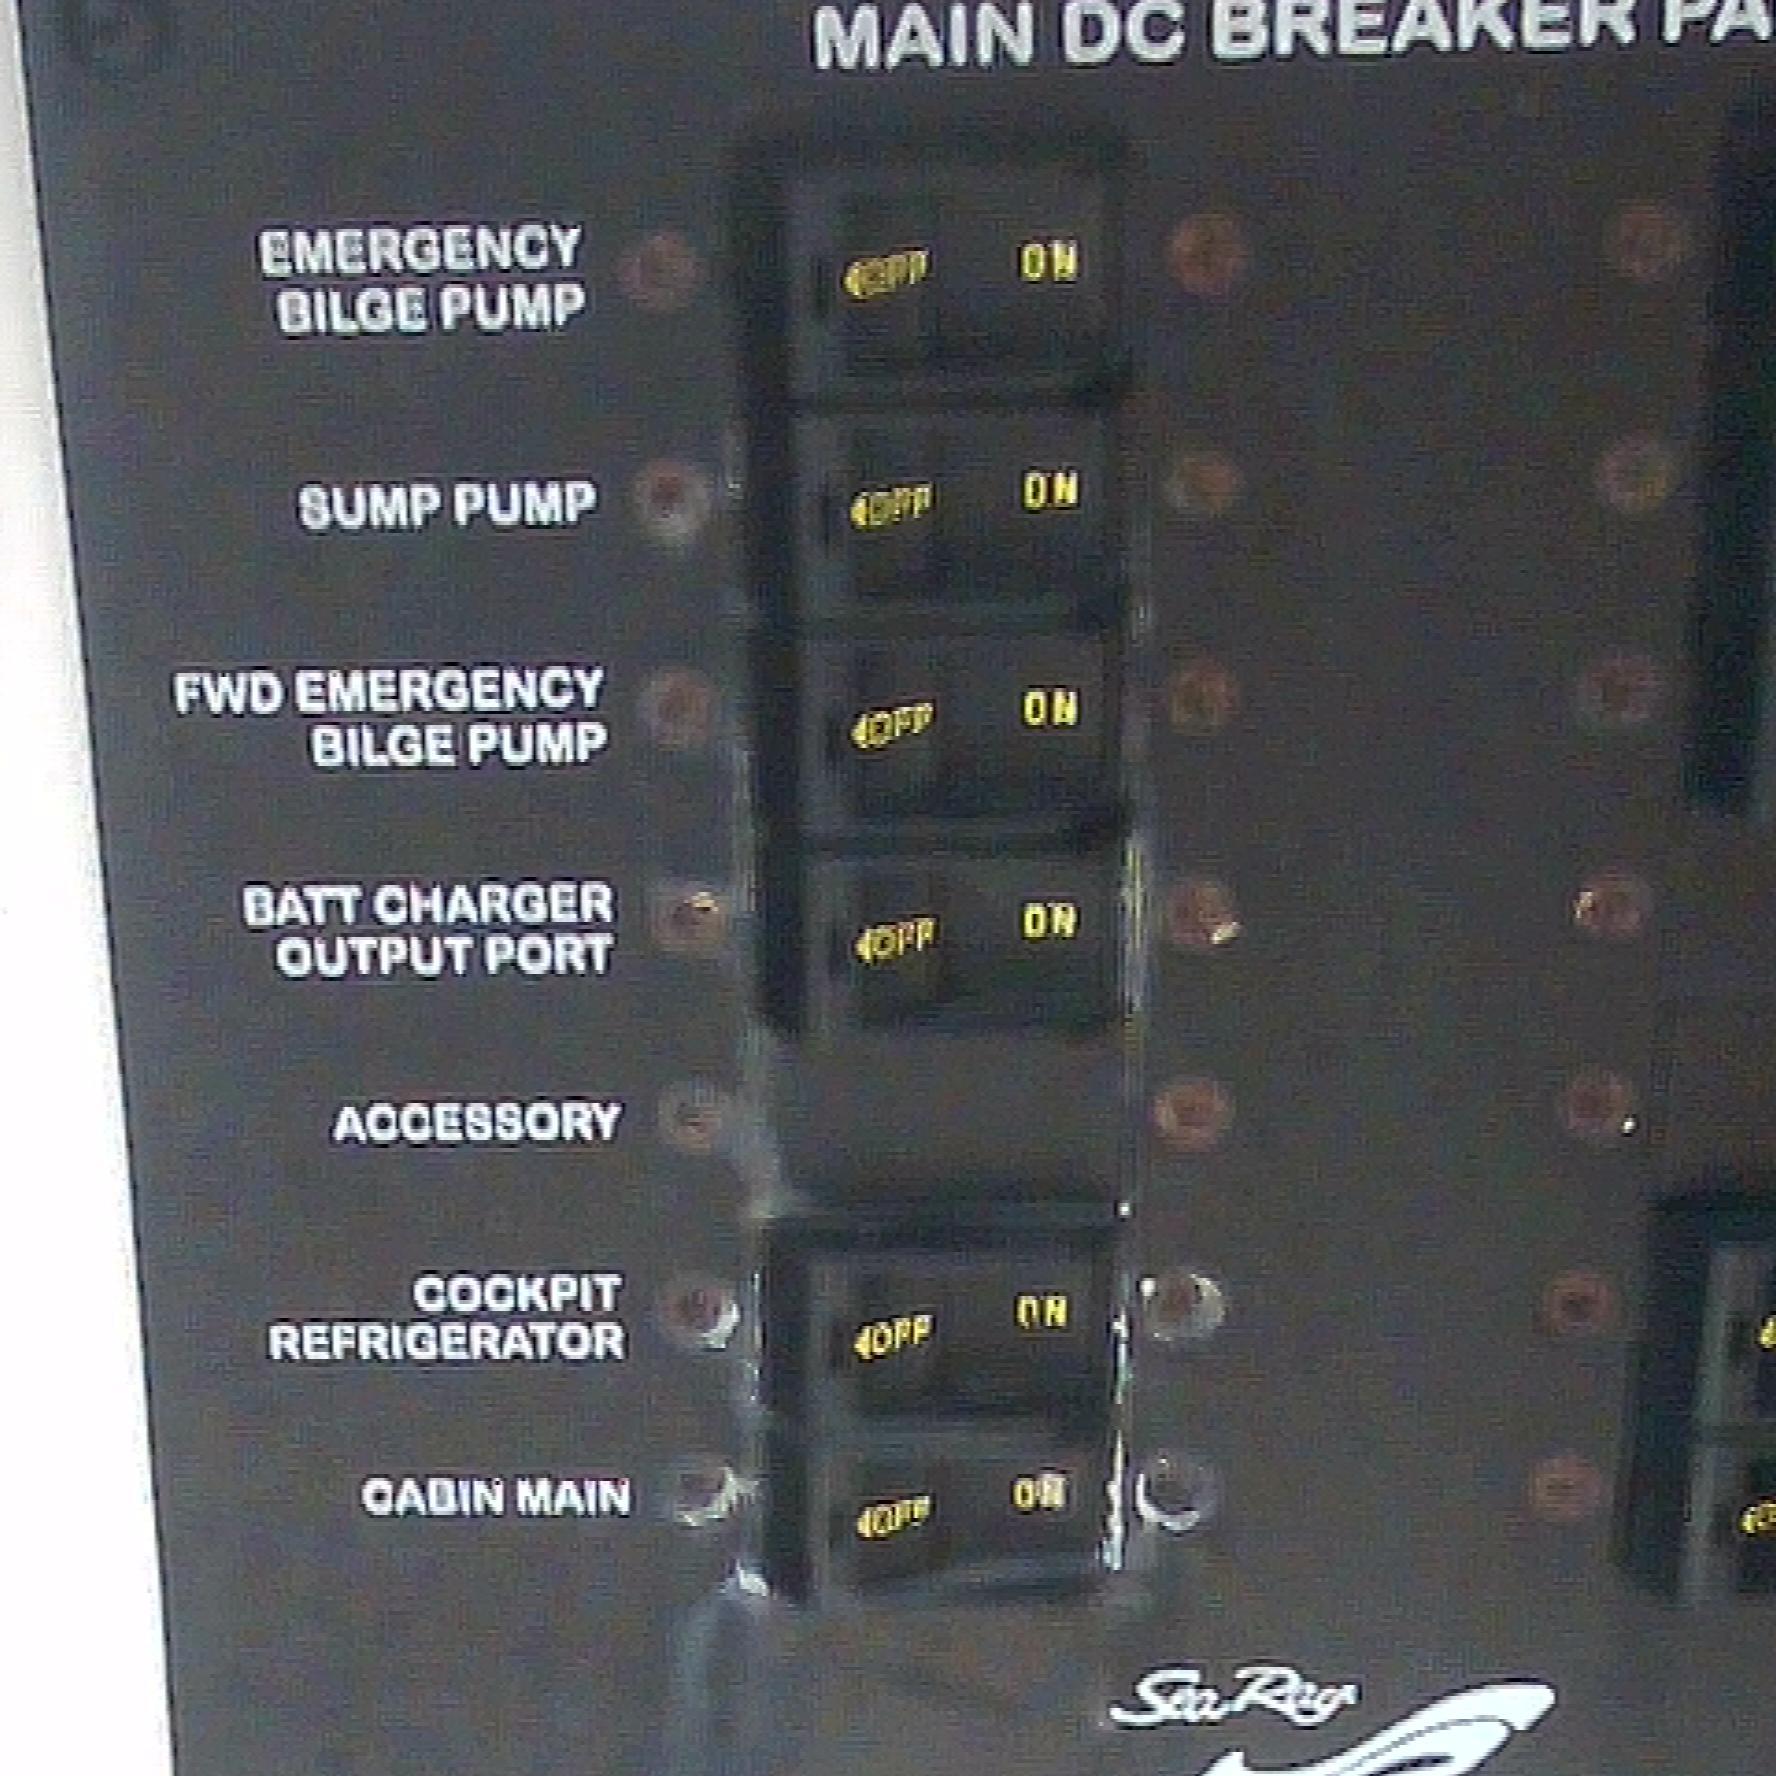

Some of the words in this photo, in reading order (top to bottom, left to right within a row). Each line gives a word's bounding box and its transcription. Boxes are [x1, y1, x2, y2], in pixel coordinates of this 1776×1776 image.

[816, 0, 1032, 69] MAIN
[1064, 0, 1184, 62] DC
[1214, 0, 1635, 58] BREAKER
[261, 225, 580, 277] EMERGENCY
[1023, 240, 1076, 281] ON
[278, 288, 427, 332] BILGE
[441, 284, 584, 329] PUMP
[300, 484, 440, 529] SUMP
[455, 481, 595, 525] PUMP
[1026, 473, 1077, 507] ON
[175, 670, 282, 714] FWD
[296, 666, 603, 714] EMERGENCY
[1025, 688, 1076, 725] ON
[313, 725, 455, 766] BILGE
[469, 722, 606, 766] PUMP
[244, 885, 361, 925] BATT
[374, 881, 611, 925] CHARGER
[1025, 903, 1075, 937] ON
[277, 937, 473, 977] OUTPUT
[486, 933, 613, 974] PORT
[334, 1103, 620, 1140] ACCESSORY
[414, 1274, 621, 1311] COCKPIT
[1019, 1296, 1066, 1326] ON
[270, 1322, 623, 1359] REFRIGERATOR
[363, 1478, 503, 1515] CABIN
[517, 1478, 629, 1515] MAIN
[1015, 1474, 1065, 1507] ON
